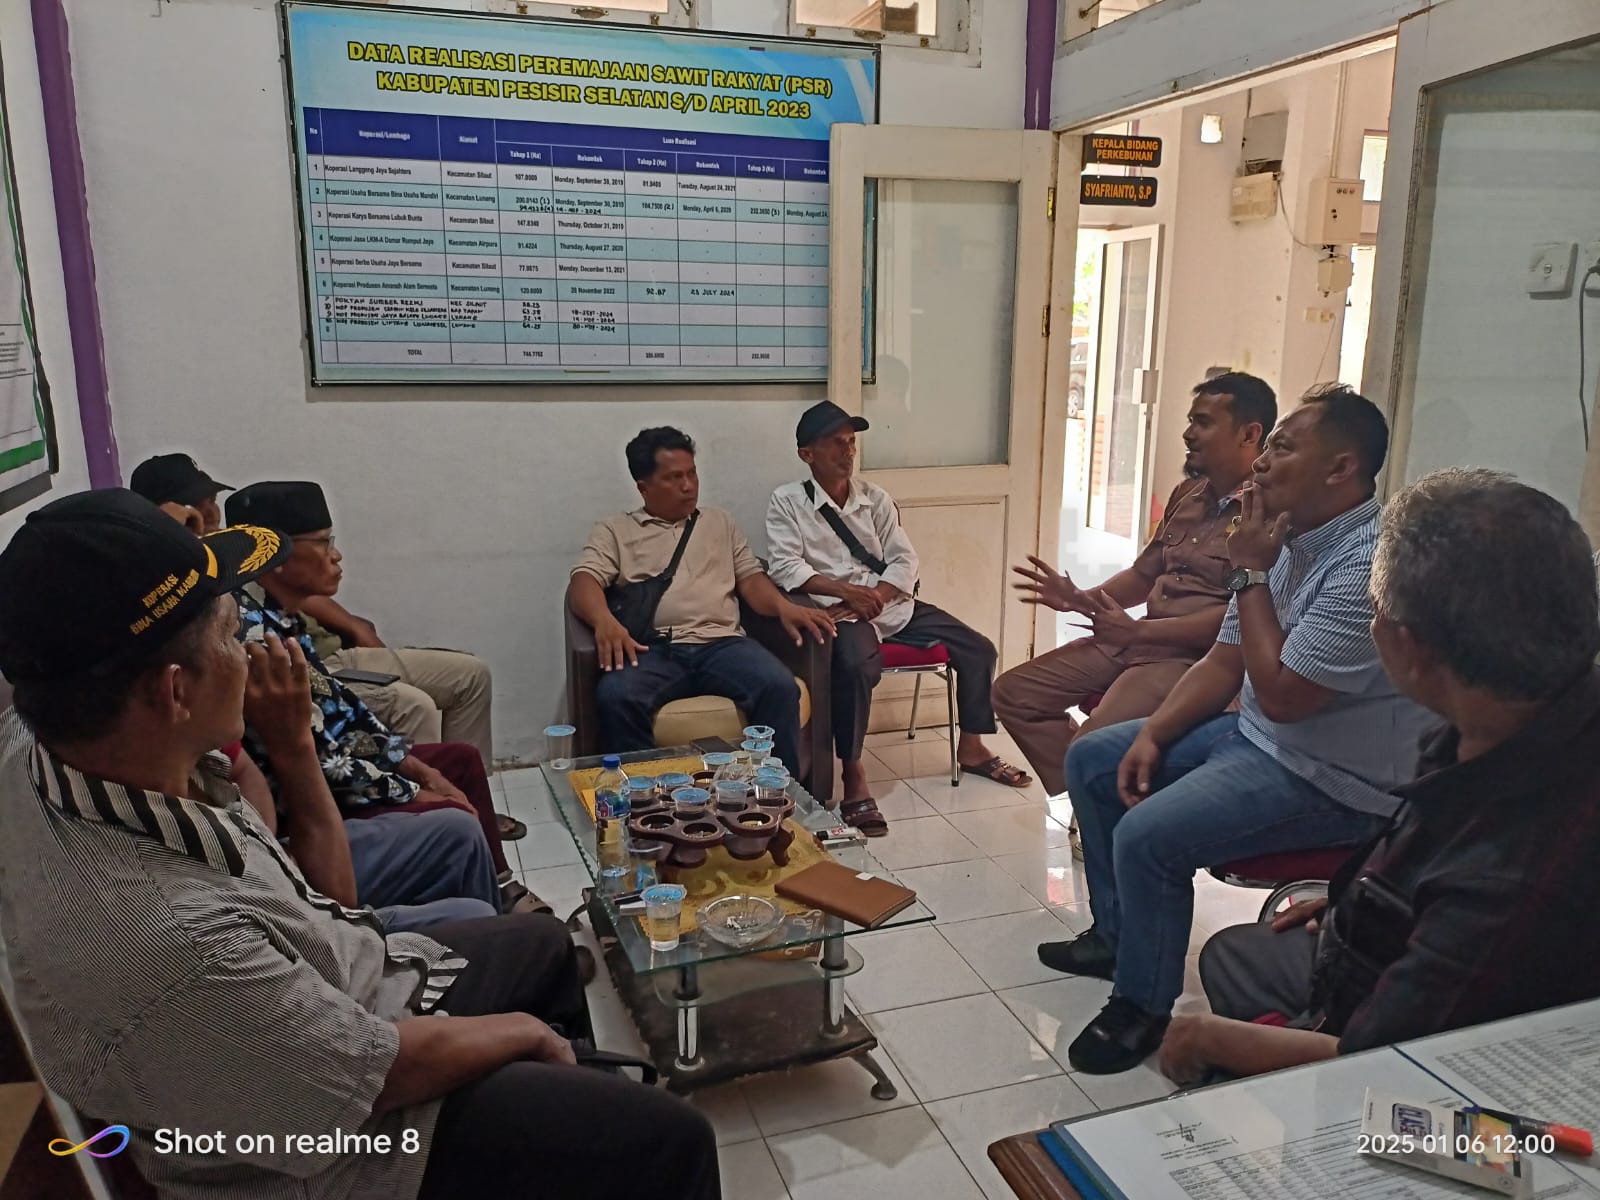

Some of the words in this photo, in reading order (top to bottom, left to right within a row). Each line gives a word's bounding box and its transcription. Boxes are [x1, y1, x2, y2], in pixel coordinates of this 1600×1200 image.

[348, 41, 405, 63] DATA
[408, 45, 515, 72] REALISASI
[519, 54, 649, 82] PEREMAJAAN
[652, 65, 709, 85] SAWIT
[712, 70, 783, 92] RAKYAT
[784, 76, 832, 98] (PSR)
[376, 71, 499, 98] KABUPATEN
[503, 81, 581, 104] PESISIR
[584, 87, 668, 109] SELATAN
[671, 93, 707, 113] S/D
[710, 96, 764, 116] APRIL
[767, 100, 811, 119] 2023
[459, 136, 478, 144] Alamat
[675, 138, 696, 146] Realisasi
[1092, 138, 1124, 149] KEPALA
[1127, 140, 1158, 150] BIDANG
[510, 151, 525, 159] Tahap
[1096, 149, 1153, 161] PERKEBUNAN
[638, 158, 652, 166] Tahap
[324, 164, 348, 173] Koperasi
[389, 167, 412, 175] Sejahtera
[748, 164, 761, 173] Tahap
[447, 170, 476, 178] Kecamatan
[477, 171, 492, 179] Silaut
[555, 175, 575, 184] Monday,
[576, 176, 600, 186] September
[678, 182, 699, 191] Tuesday,
[700, 183, 716, 192] August
[1085, 182, 1136, 201] SYAFRIANTO,
[1139, 185, 1152, 200] S.P
[326, 188, 349, 197] Koperasi
[351, 189, 366, 197] Usaha
[391, 190, 402, 198] Bina
[555, 199, 576, 207] Monday,
[577, 200, 600, 208] September
[683, 204, 702, 213] Monday,
[703, 205, 715, 214] April
[787, 209, 804, 217] Monday,
[805, 210, 821, 218] August
[328, 212, 350, 220] Koperasi
[352, 213, 367, 221] Karya
[368, 213, 390, 221] Bersama
[558, 221, 582, 229] Thursday,
[330, 234, 352, 243] Koperasi
[402, 238, 421, 246] Rumput
[423, 238, 434, 246] Jaya
[479, 240, 498, 248] Airpura
[560, 243, 584, 251] Thursday,
[585, 244, 602, 252] August
[331, 258, 354, 267] Koperasi
[387, 260, 399, 268] Jaya
[559, 265, 580, 273] Monday,
[580, 265, 604, 273] December
[333, 281, 356, 290] Koperasi
[142, 573, 180, 609] KOPERASI
[130, 615, 154, 635] BINA
[152, 594, 181, 620] USAHA
